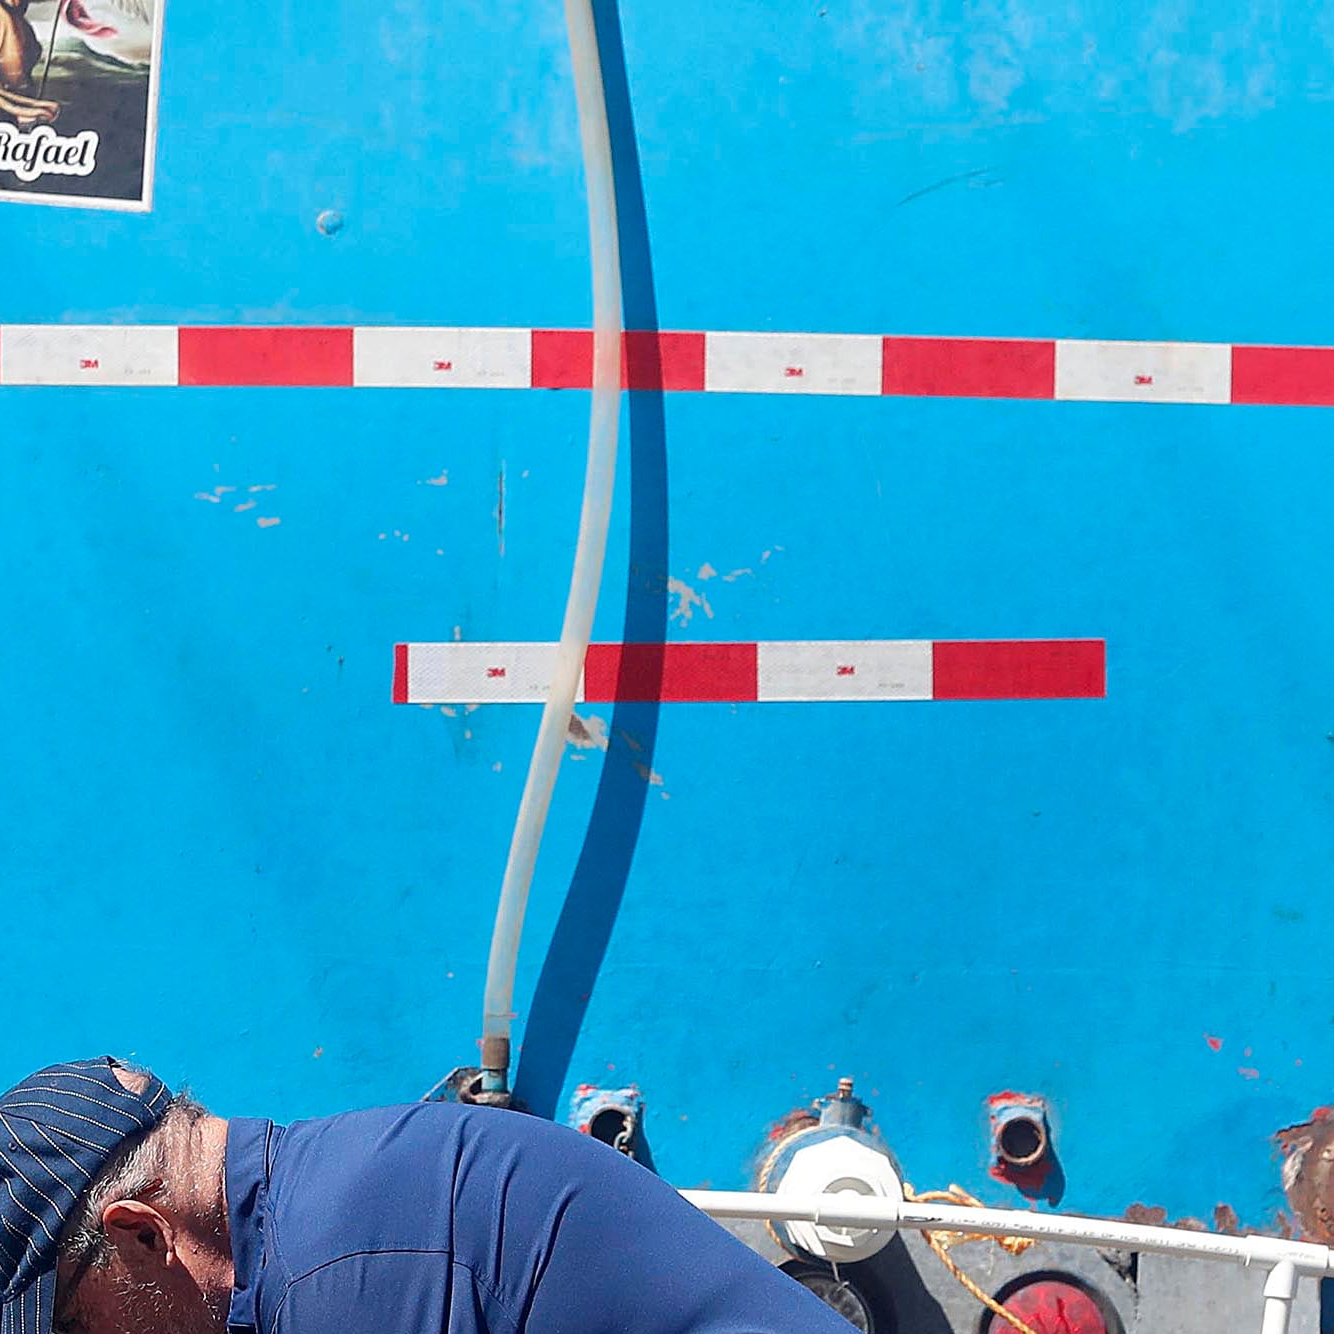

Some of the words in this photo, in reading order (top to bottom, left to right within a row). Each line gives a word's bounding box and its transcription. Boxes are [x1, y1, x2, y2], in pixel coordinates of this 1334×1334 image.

[79, 359, 100, 370] 3M
[433, 360, 452, 372] 3M
[785, 367, 804, 378] 3M
[1134, 375, 1153, 386] 3M
[488, 668, 506, 679] 3M
[837, 666, 856, 677] 3M
